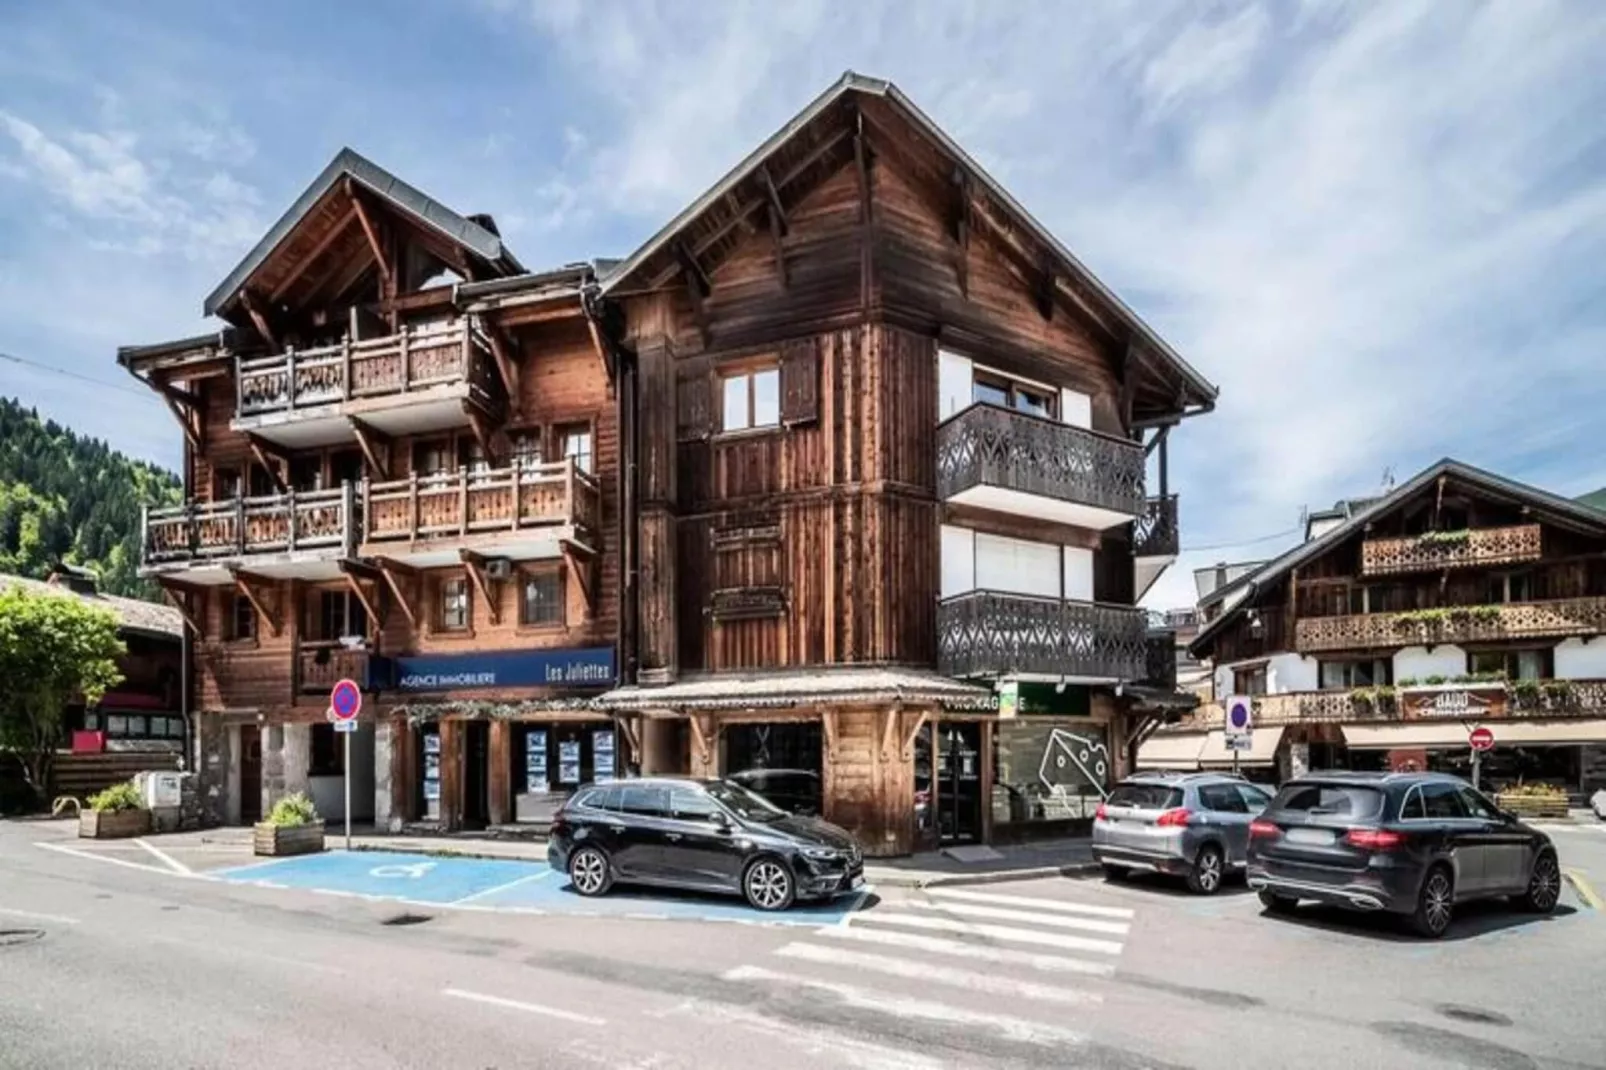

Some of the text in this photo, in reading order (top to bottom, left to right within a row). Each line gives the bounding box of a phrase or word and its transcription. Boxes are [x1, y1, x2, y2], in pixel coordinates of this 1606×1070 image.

[545, 660, 610, 681] Les Juliettes
[400, 673, 437, 687] AGENCE
